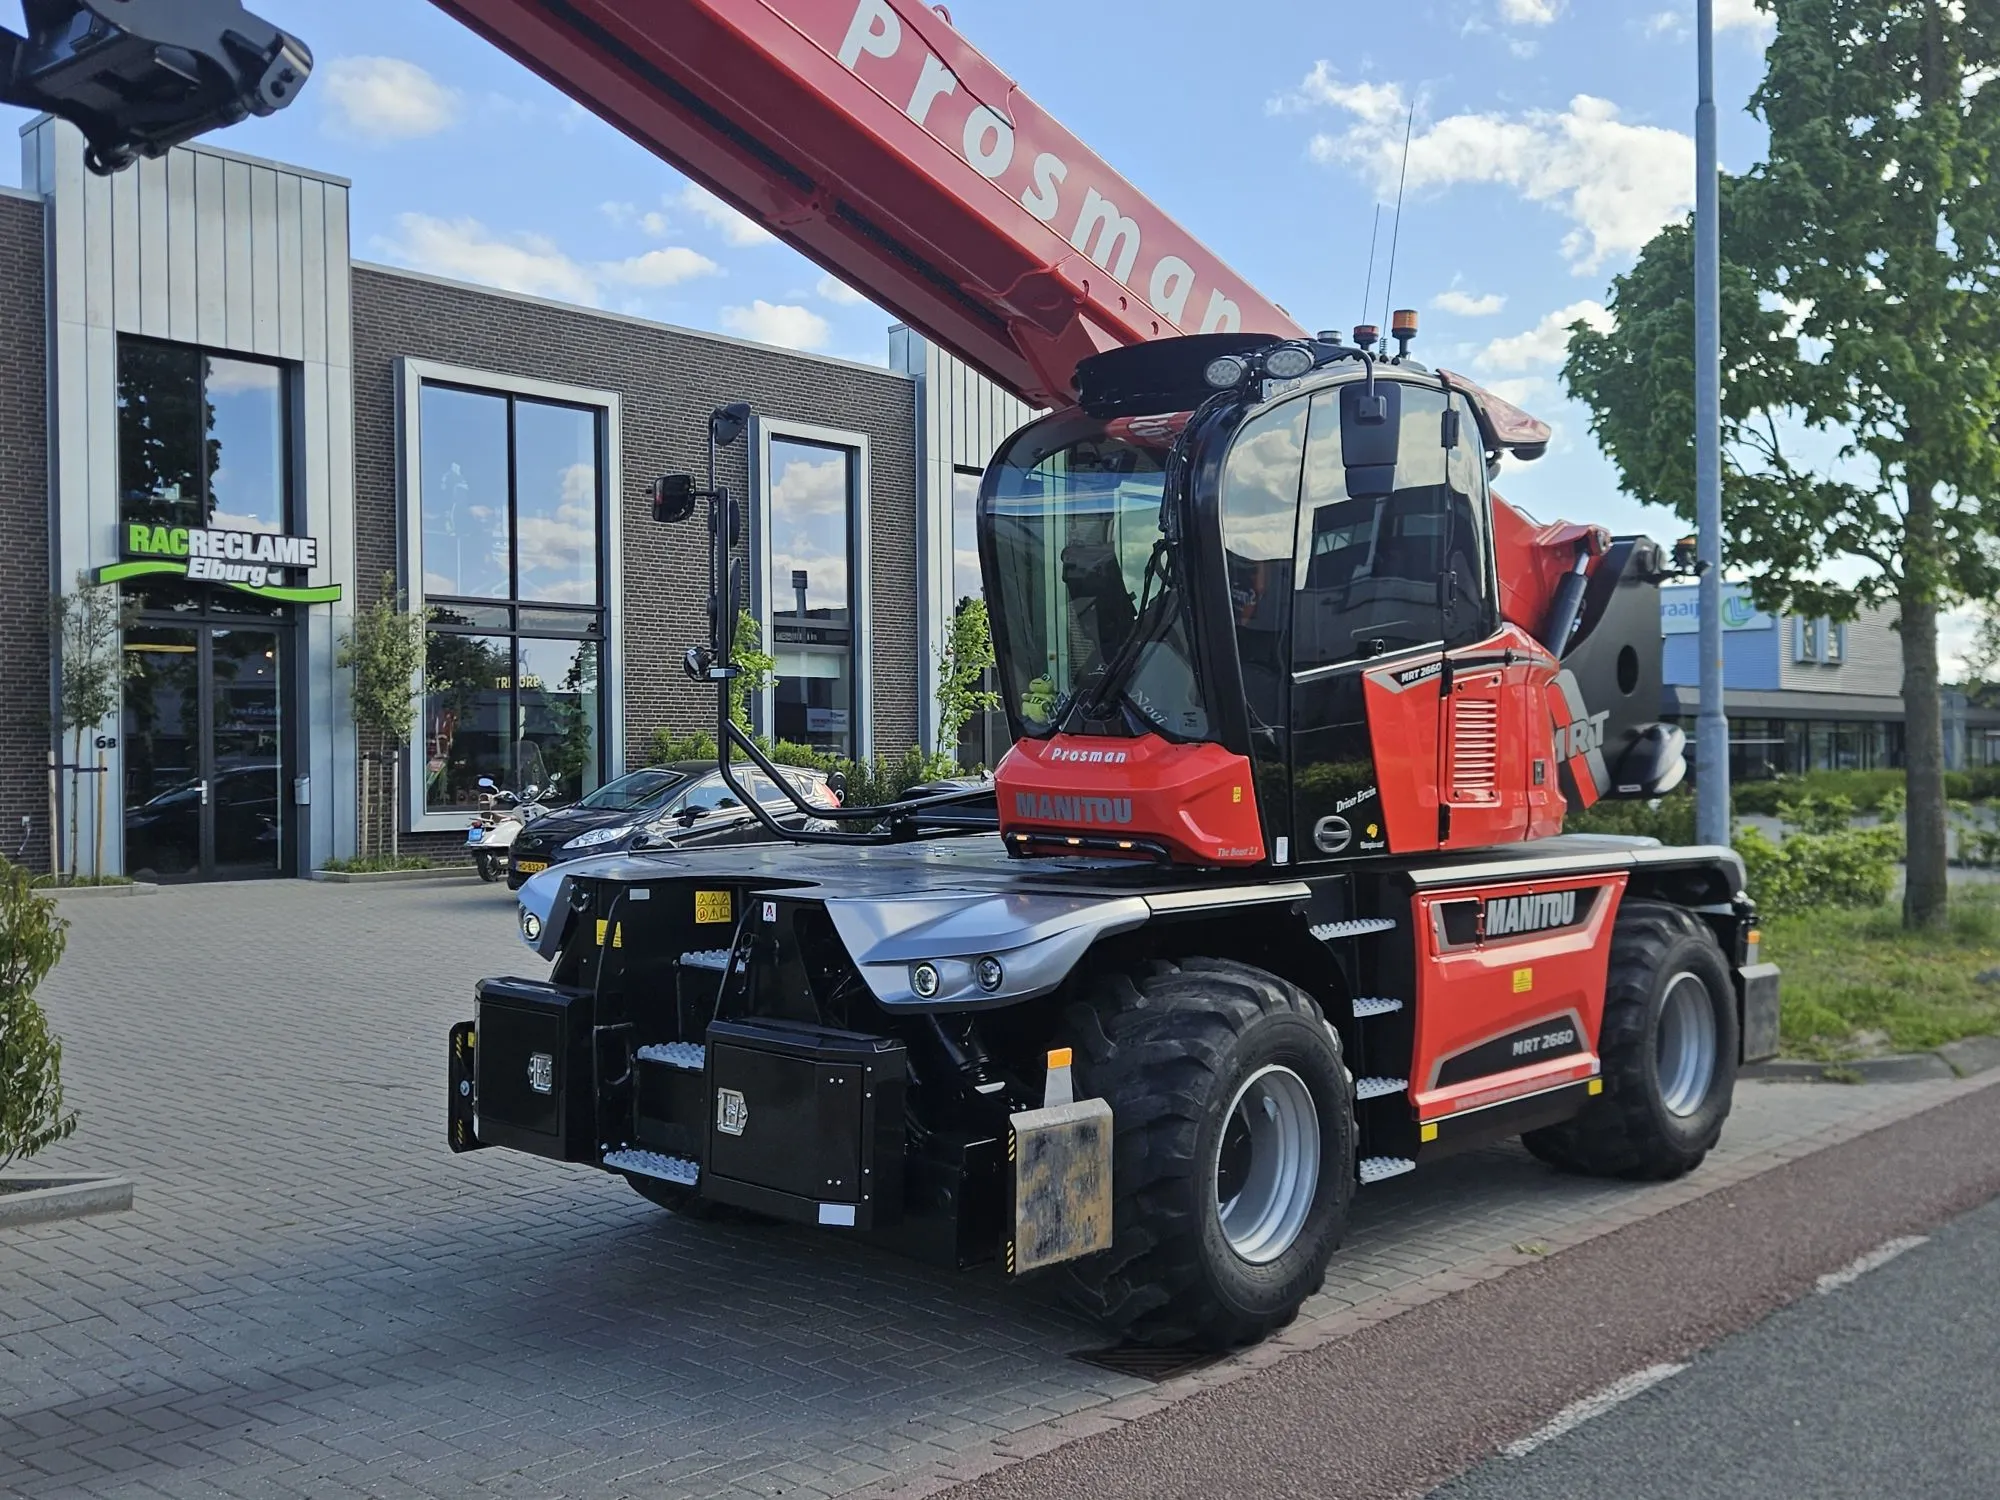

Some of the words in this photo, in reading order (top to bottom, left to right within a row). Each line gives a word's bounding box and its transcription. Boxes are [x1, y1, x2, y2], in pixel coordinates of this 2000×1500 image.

[837, 0, 1241, 334] Prosman
[187, 556, 268, 587] Elburg
[1401, 669, 1420, 683] MRT
[1420, 662, 1442, 677] 2660
[1051, 747, 1126, 763] Prosman
[1015, 791, 1133, 824] MANITOU
[1486, 891, 1576, 936] MANITOU
[1512, 1036, 1541, 1056] MRT
[1541, 1029, 1574, 1050] 2660
